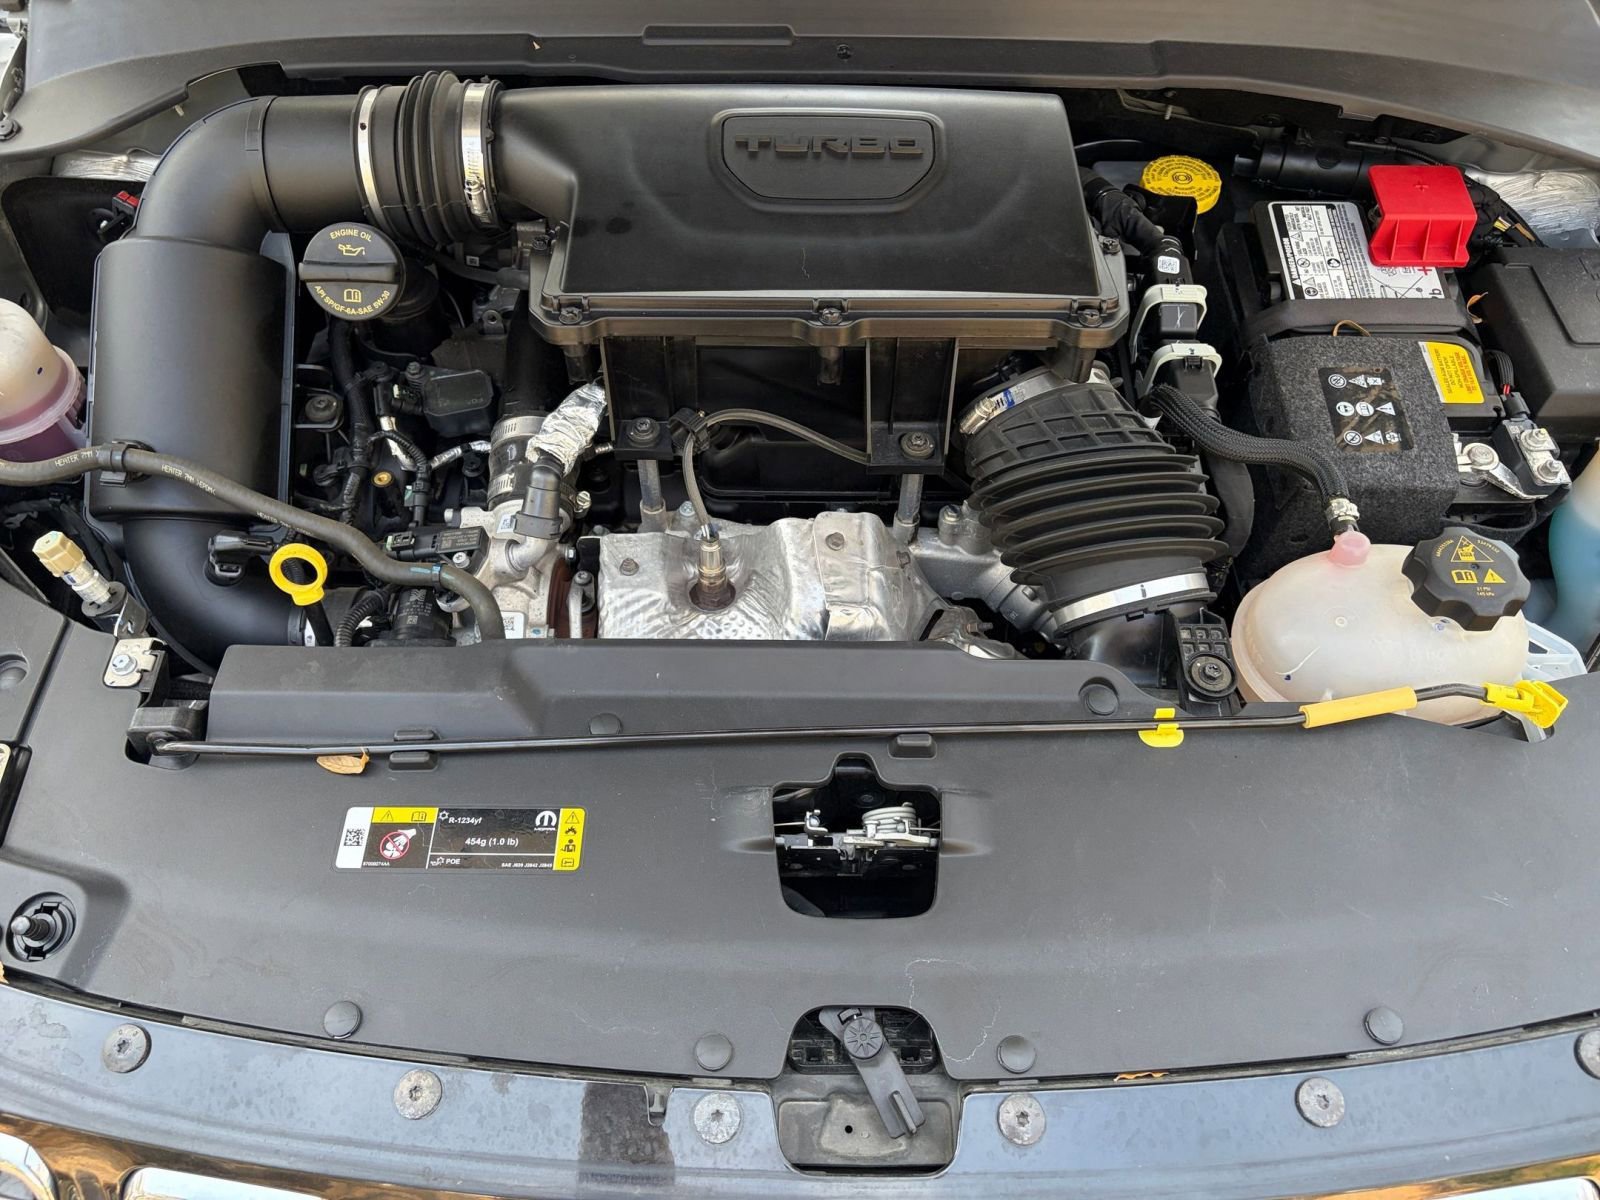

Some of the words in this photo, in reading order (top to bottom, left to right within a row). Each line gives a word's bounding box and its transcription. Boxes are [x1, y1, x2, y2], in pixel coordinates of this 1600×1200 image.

[735, 134, 923, 155] TURBO
[330, 228, 359, 240] ENGINE
[360, 231, 372, 242] OIL
[315, 286, 326, 298] API
[324, 296, 374, 315] SP/GF-6A-SAE
[372, 290, 390, 309] 5W-30
[54, 454, 79, 467] HEATER
[161, 464, 183, 478] HEATER
[448, 816, 482, 825] R-1234yf
[465, 838, 487, 847] 454g
[488, 838, 506, 847] (1.0
[507, 838, 519, 847] lb)
